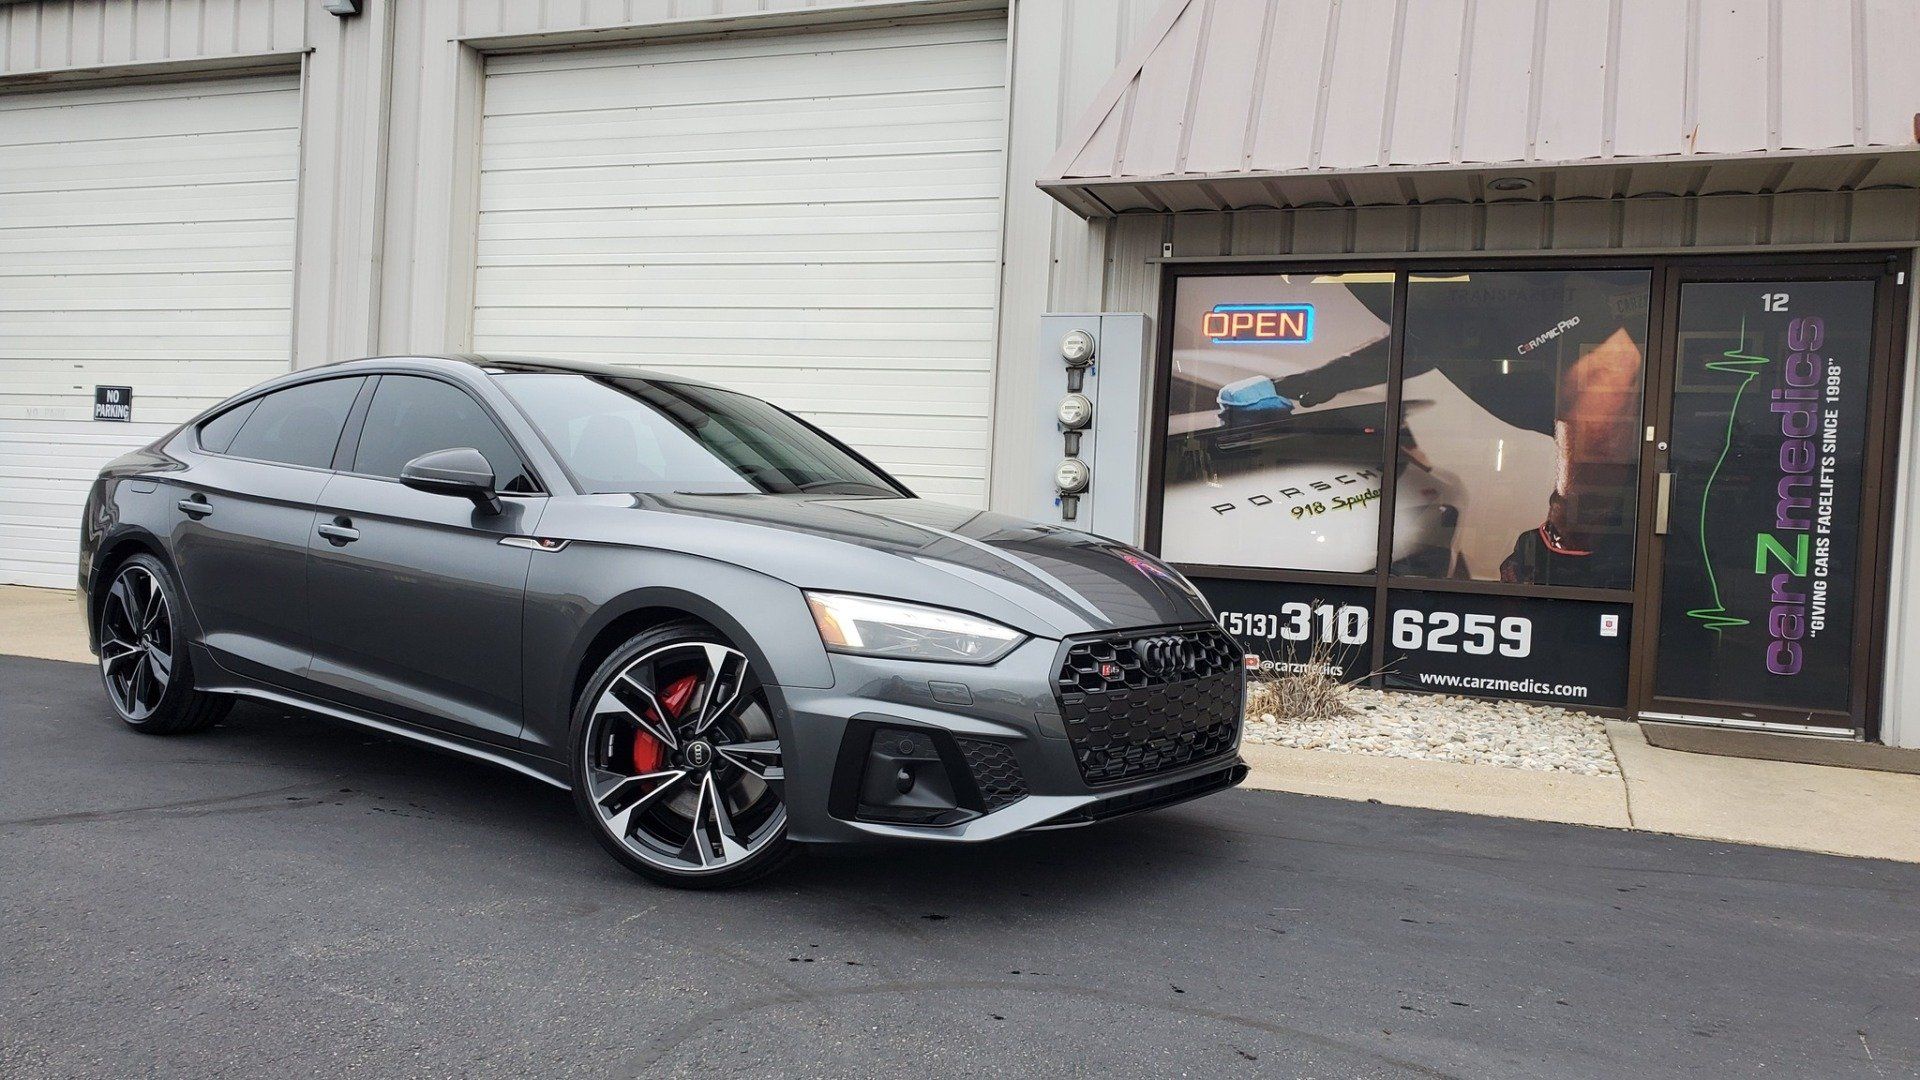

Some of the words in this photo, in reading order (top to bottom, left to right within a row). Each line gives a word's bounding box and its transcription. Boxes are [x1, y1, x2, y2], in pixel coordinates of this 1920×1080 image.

[1761, 293, 1790, 312] 12
[1203, 311, 1305, 338] OPEN
[95, 403, 130, 418] PARKING
[106, 389, 120, 403] NO
[1822, 409, 1839, 454] SINCE
[1211, 468, 1380, 515] PORSCH
[1291, 501, 1326, 519] 918
[1332, 488, 1382, 510] Spyde
[1817, 456, 1836, 534] FACELIFTS
[1815, 537, 1830, 577] CARS
[1280, 601, 1369, 645] 310
[1392, 609, 1532, 658] 6259
[1420, 672, 1588, 698] www.carzmedics.com
